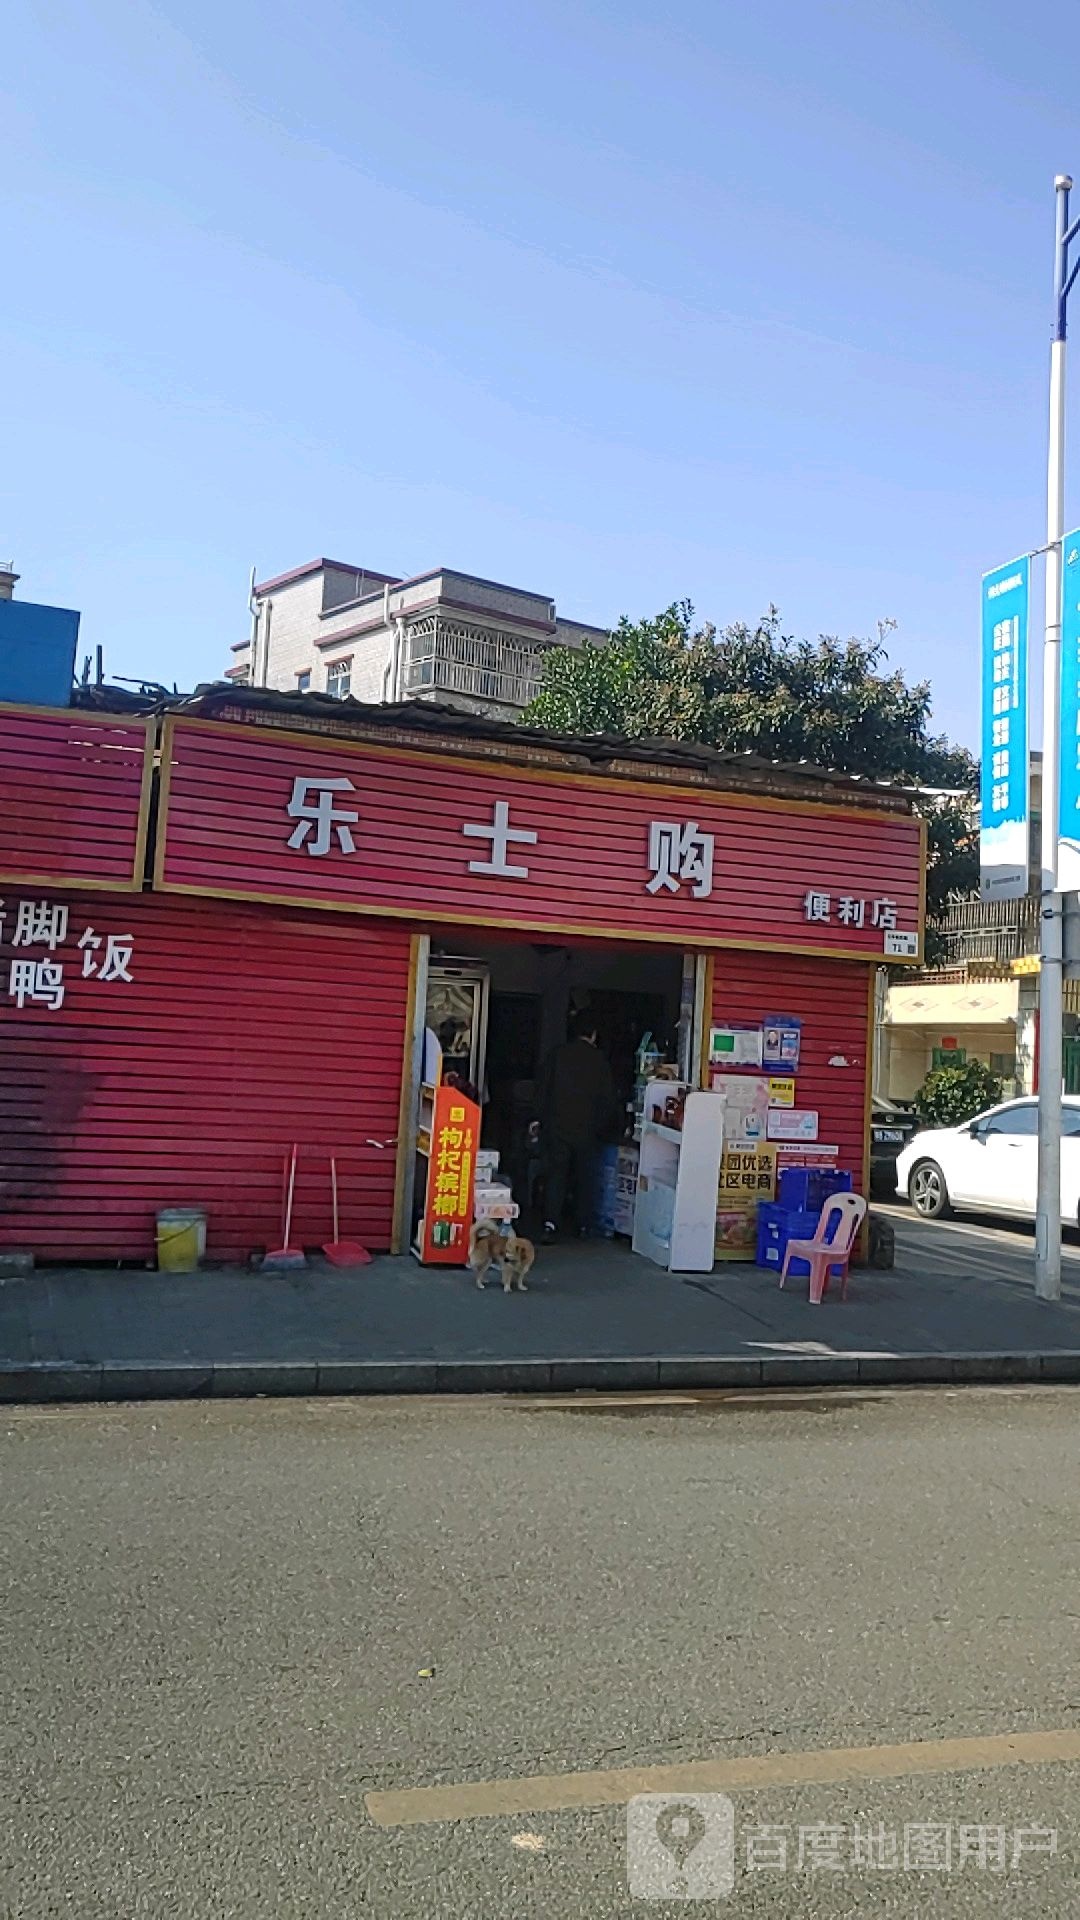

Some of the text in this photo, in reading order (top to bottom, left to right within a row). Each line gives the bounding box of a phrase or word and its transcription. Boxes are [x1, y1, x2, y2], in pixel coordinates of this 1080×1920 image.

[286, 777, 715, 898] 乐士购
[0, 900, 69, 951] 脚
[804, 890, 898, 929] 便利店
[432, 1127, 464, 1217] 枸杞槟榔
[720, 1154, 773, 1171] 团优选
